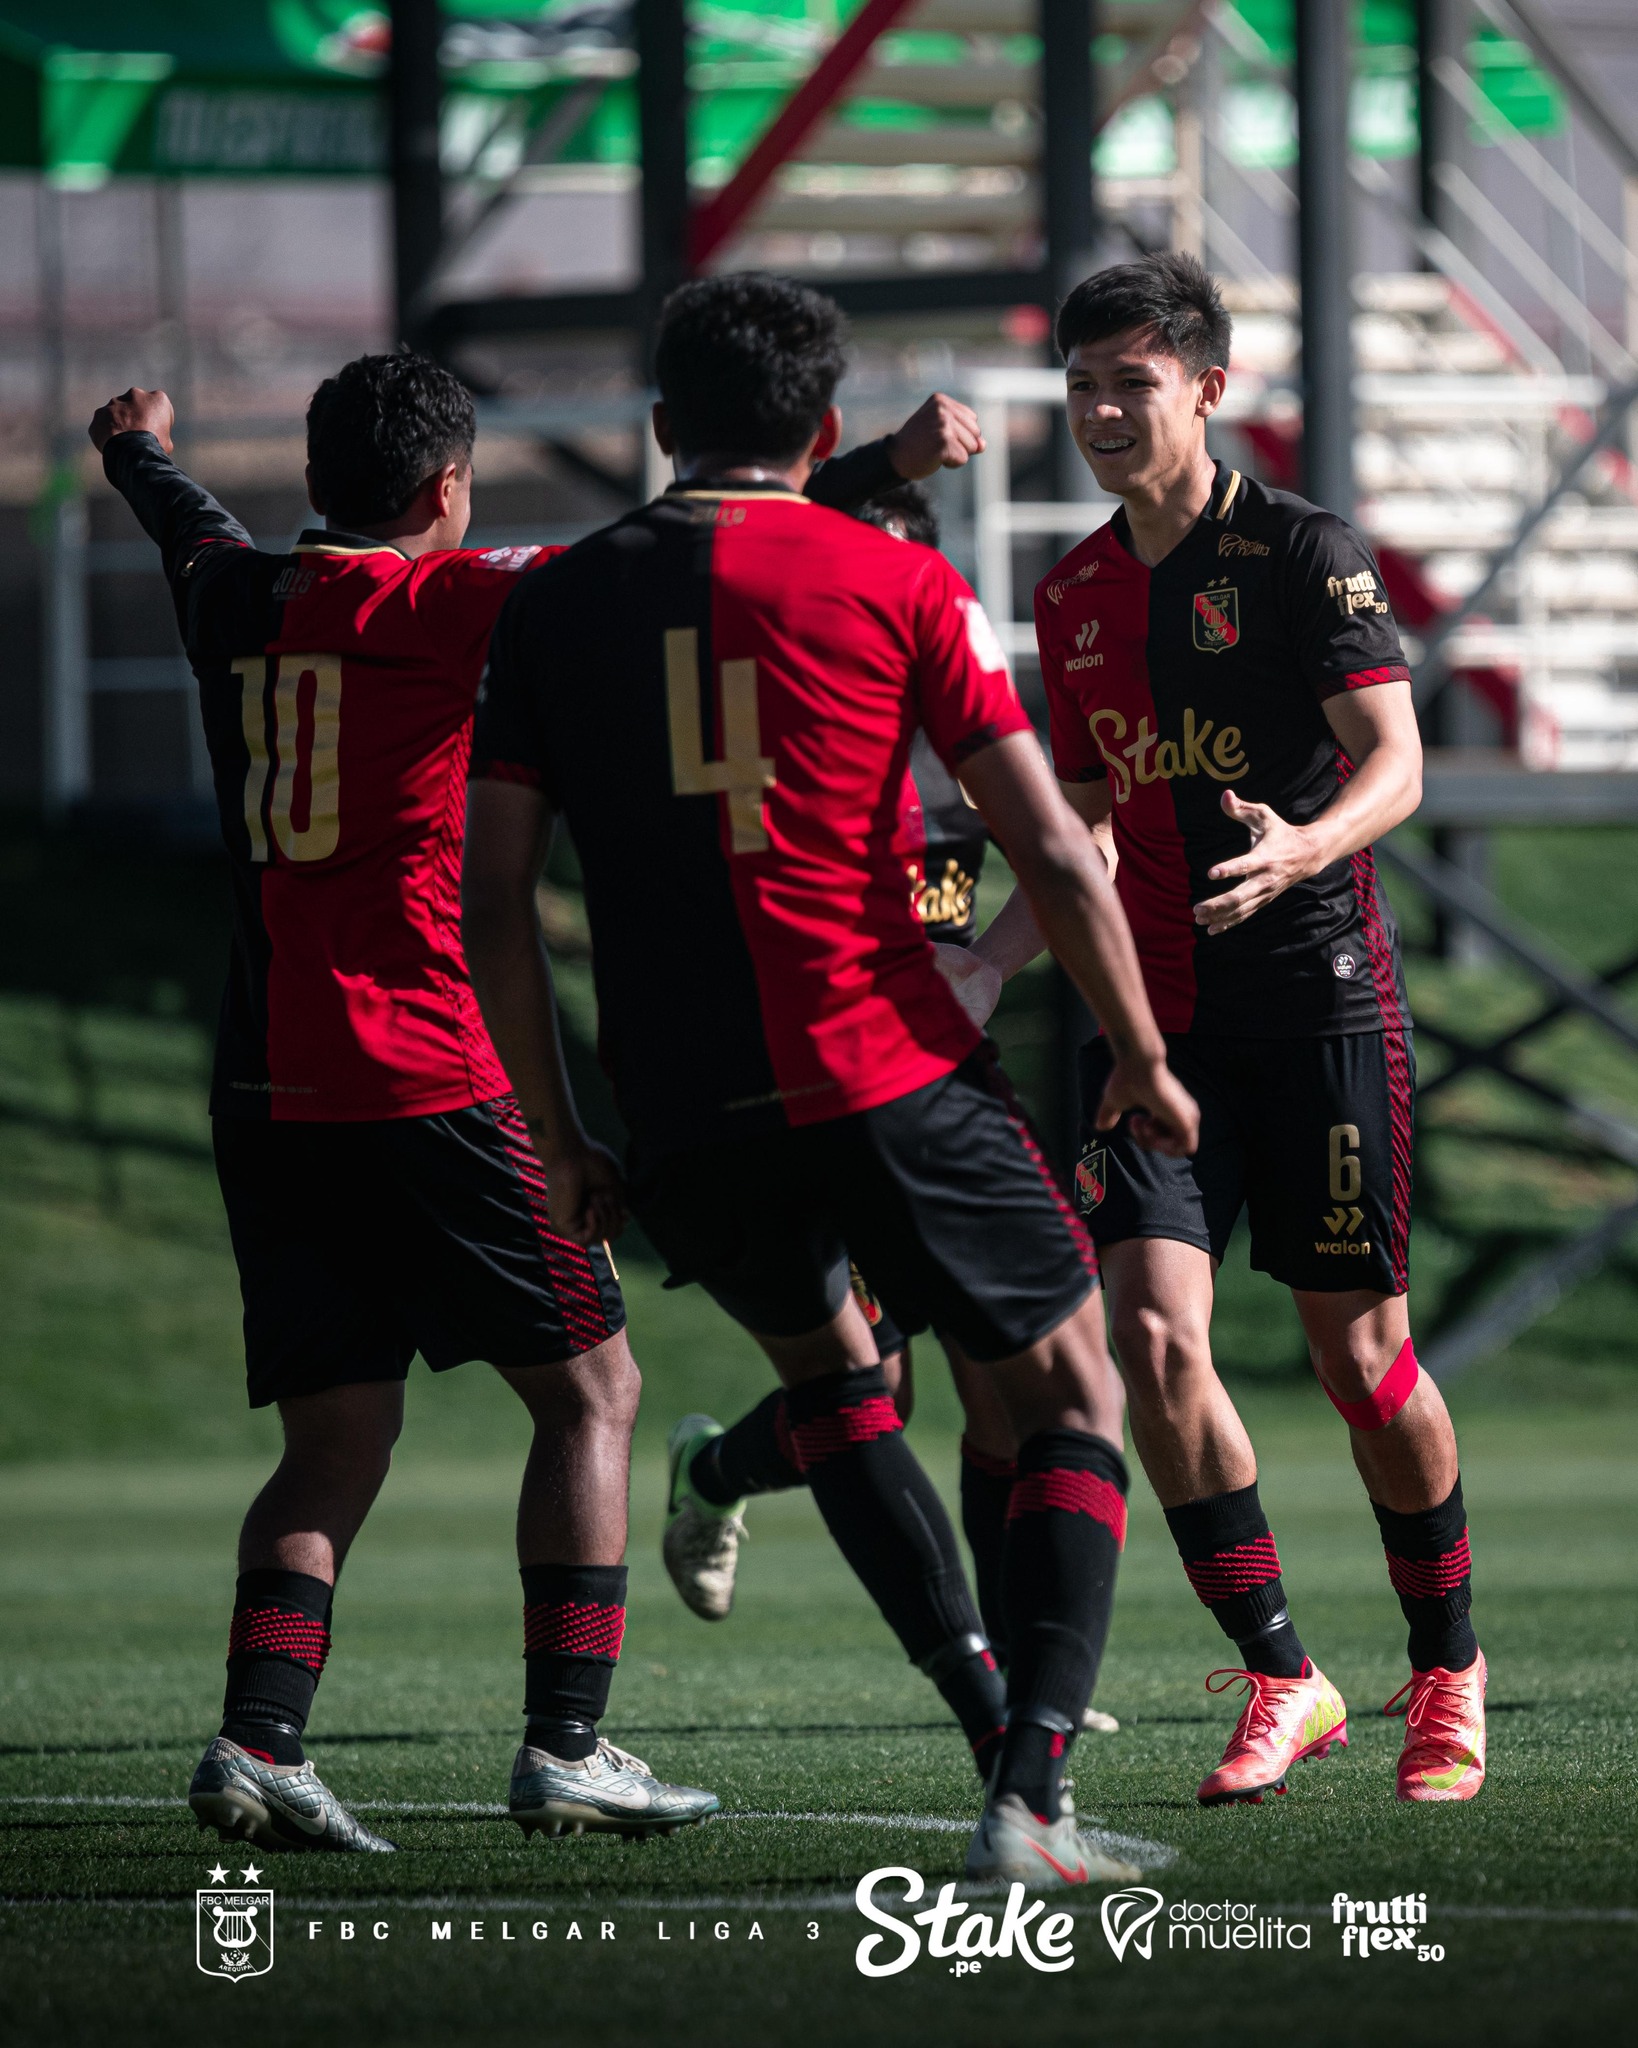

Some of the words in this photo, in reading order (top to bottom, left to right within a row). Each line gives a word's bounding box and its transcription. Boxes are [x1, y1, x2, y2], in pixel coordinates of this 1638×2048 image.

[1327, 570, 1377, 597] frutti
[1337, 591, 1376, 616] flex
[1375, 602, 1388, 614] 50
[1065, 653, 1104, 673] walon
[231, 653, 342, 862] 10
[664, 626, 777, 854] 4
[1089, 707, 1250, 805] Stake
[1329, 1124, 1361, 1201] 6
[1315, 1239, 1371, 1255] walon
